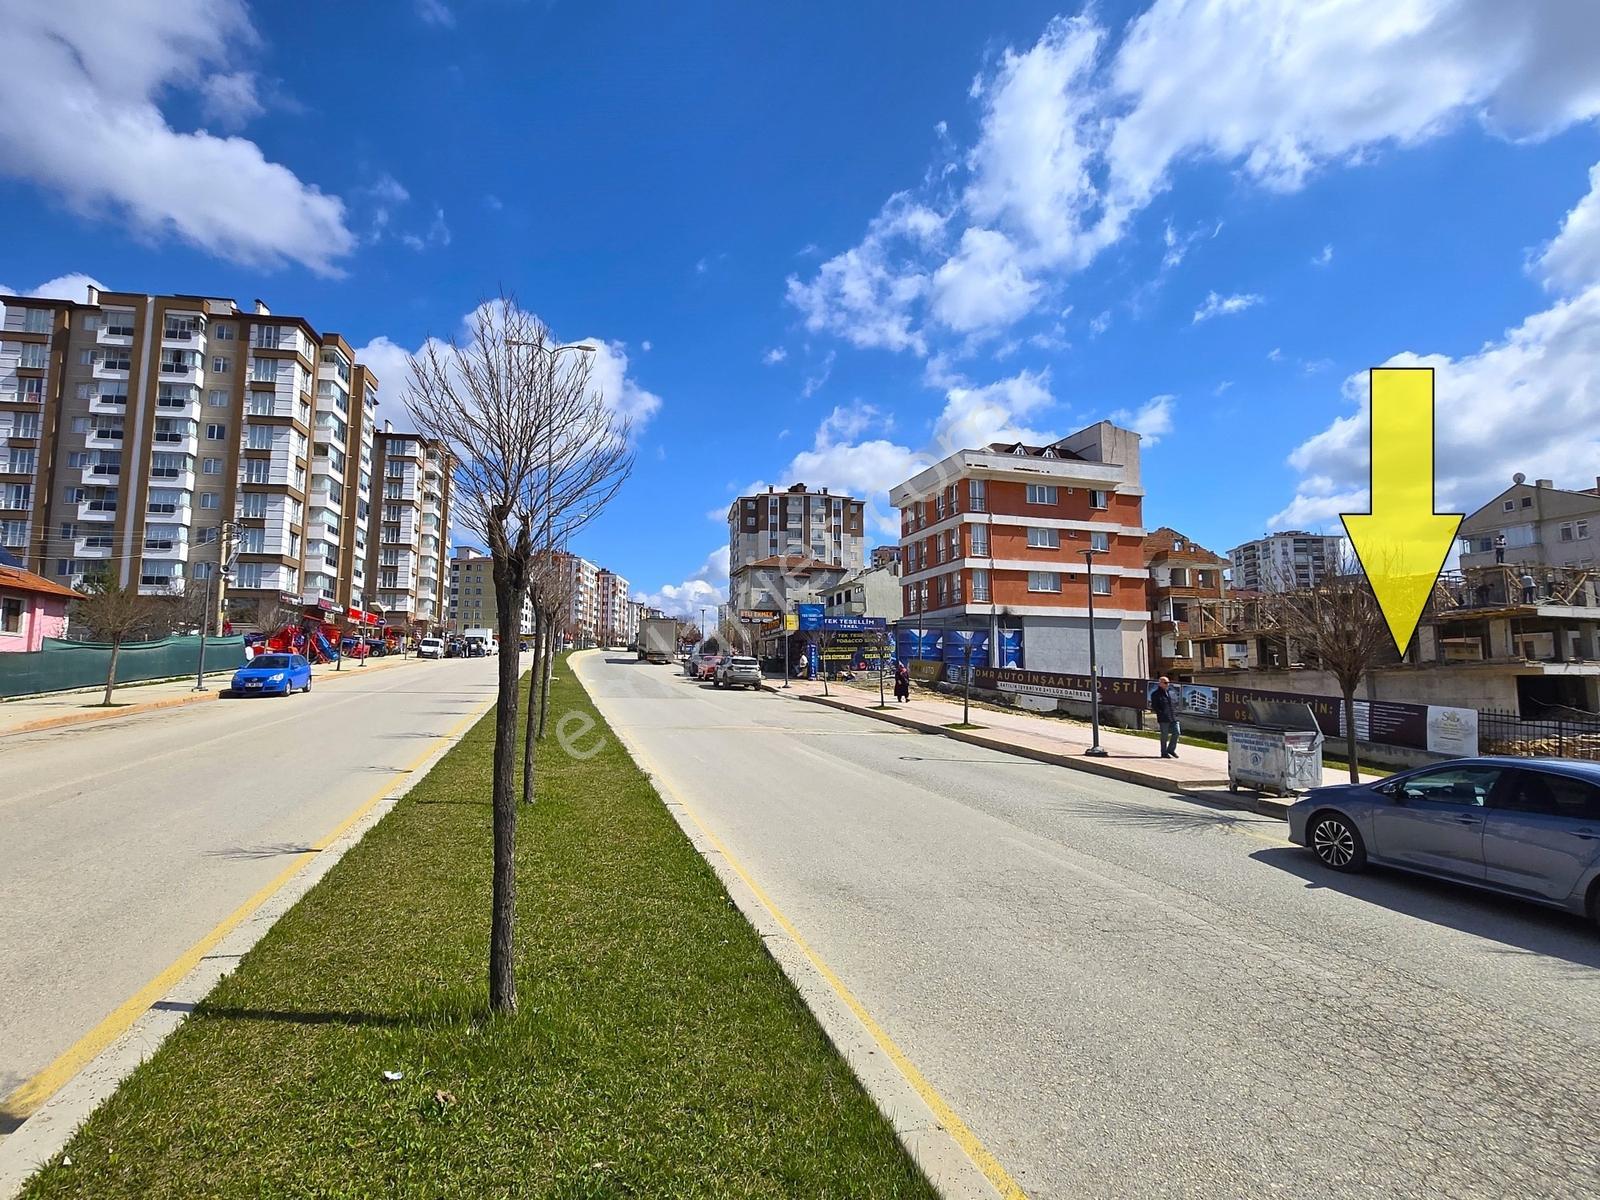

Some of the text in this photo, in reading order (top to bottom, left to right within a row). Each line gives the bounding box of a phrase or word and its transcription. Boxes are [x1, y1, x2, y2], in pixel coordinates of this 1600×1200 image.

[997, 671, 1024, 682] AUTO
[1027, 672, 1074, 687] İNŞAAT
[1112, 680, 1144, 694] ŞTİ.
[1064, 689, 1091, 698] DAİRELE
